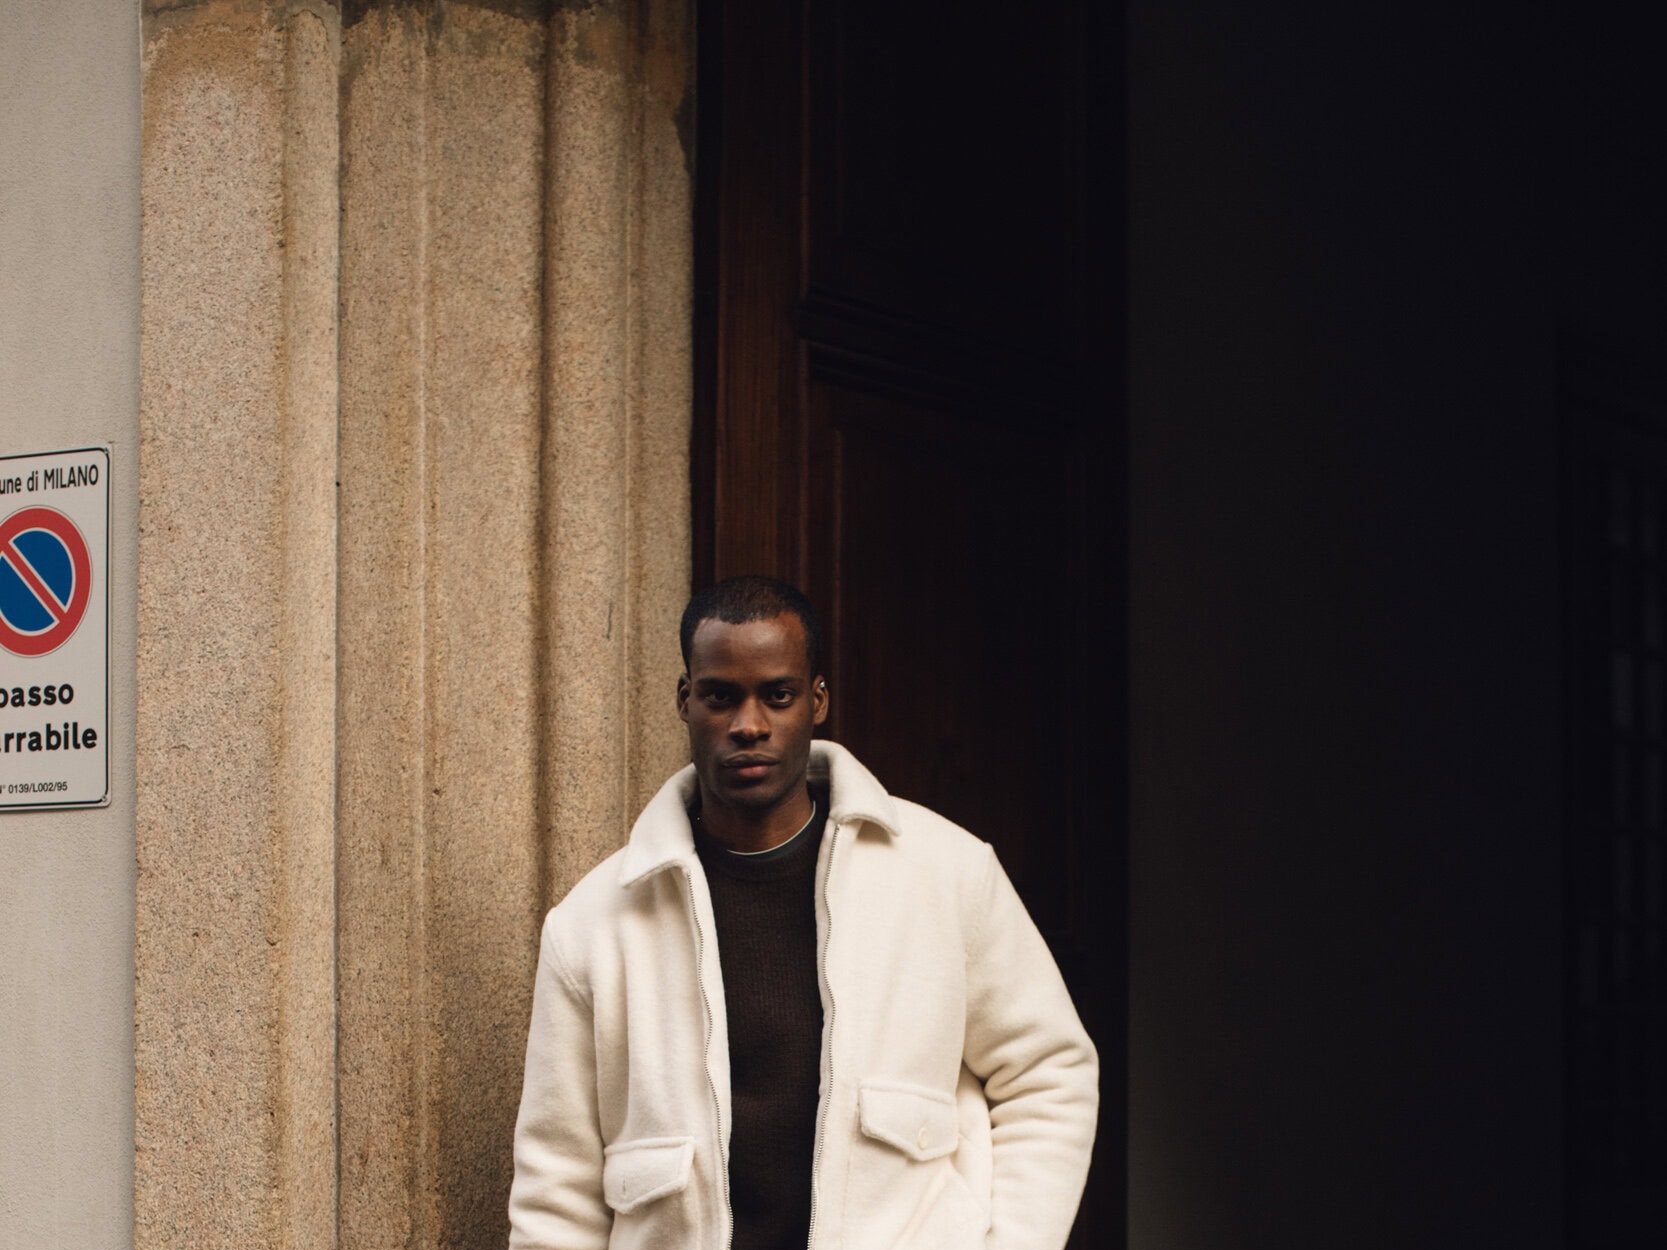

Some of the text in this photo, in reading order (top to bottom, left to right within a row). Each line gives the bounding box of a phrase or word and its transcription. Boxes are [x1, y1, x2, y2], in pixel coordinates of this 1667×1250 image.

[26, 470, 38, 492] di
[43, 464, 99, 490] MILANO
[0, 721, 98, 753] rrabile
[8, 781, 68, 794] 0139/L002/95
